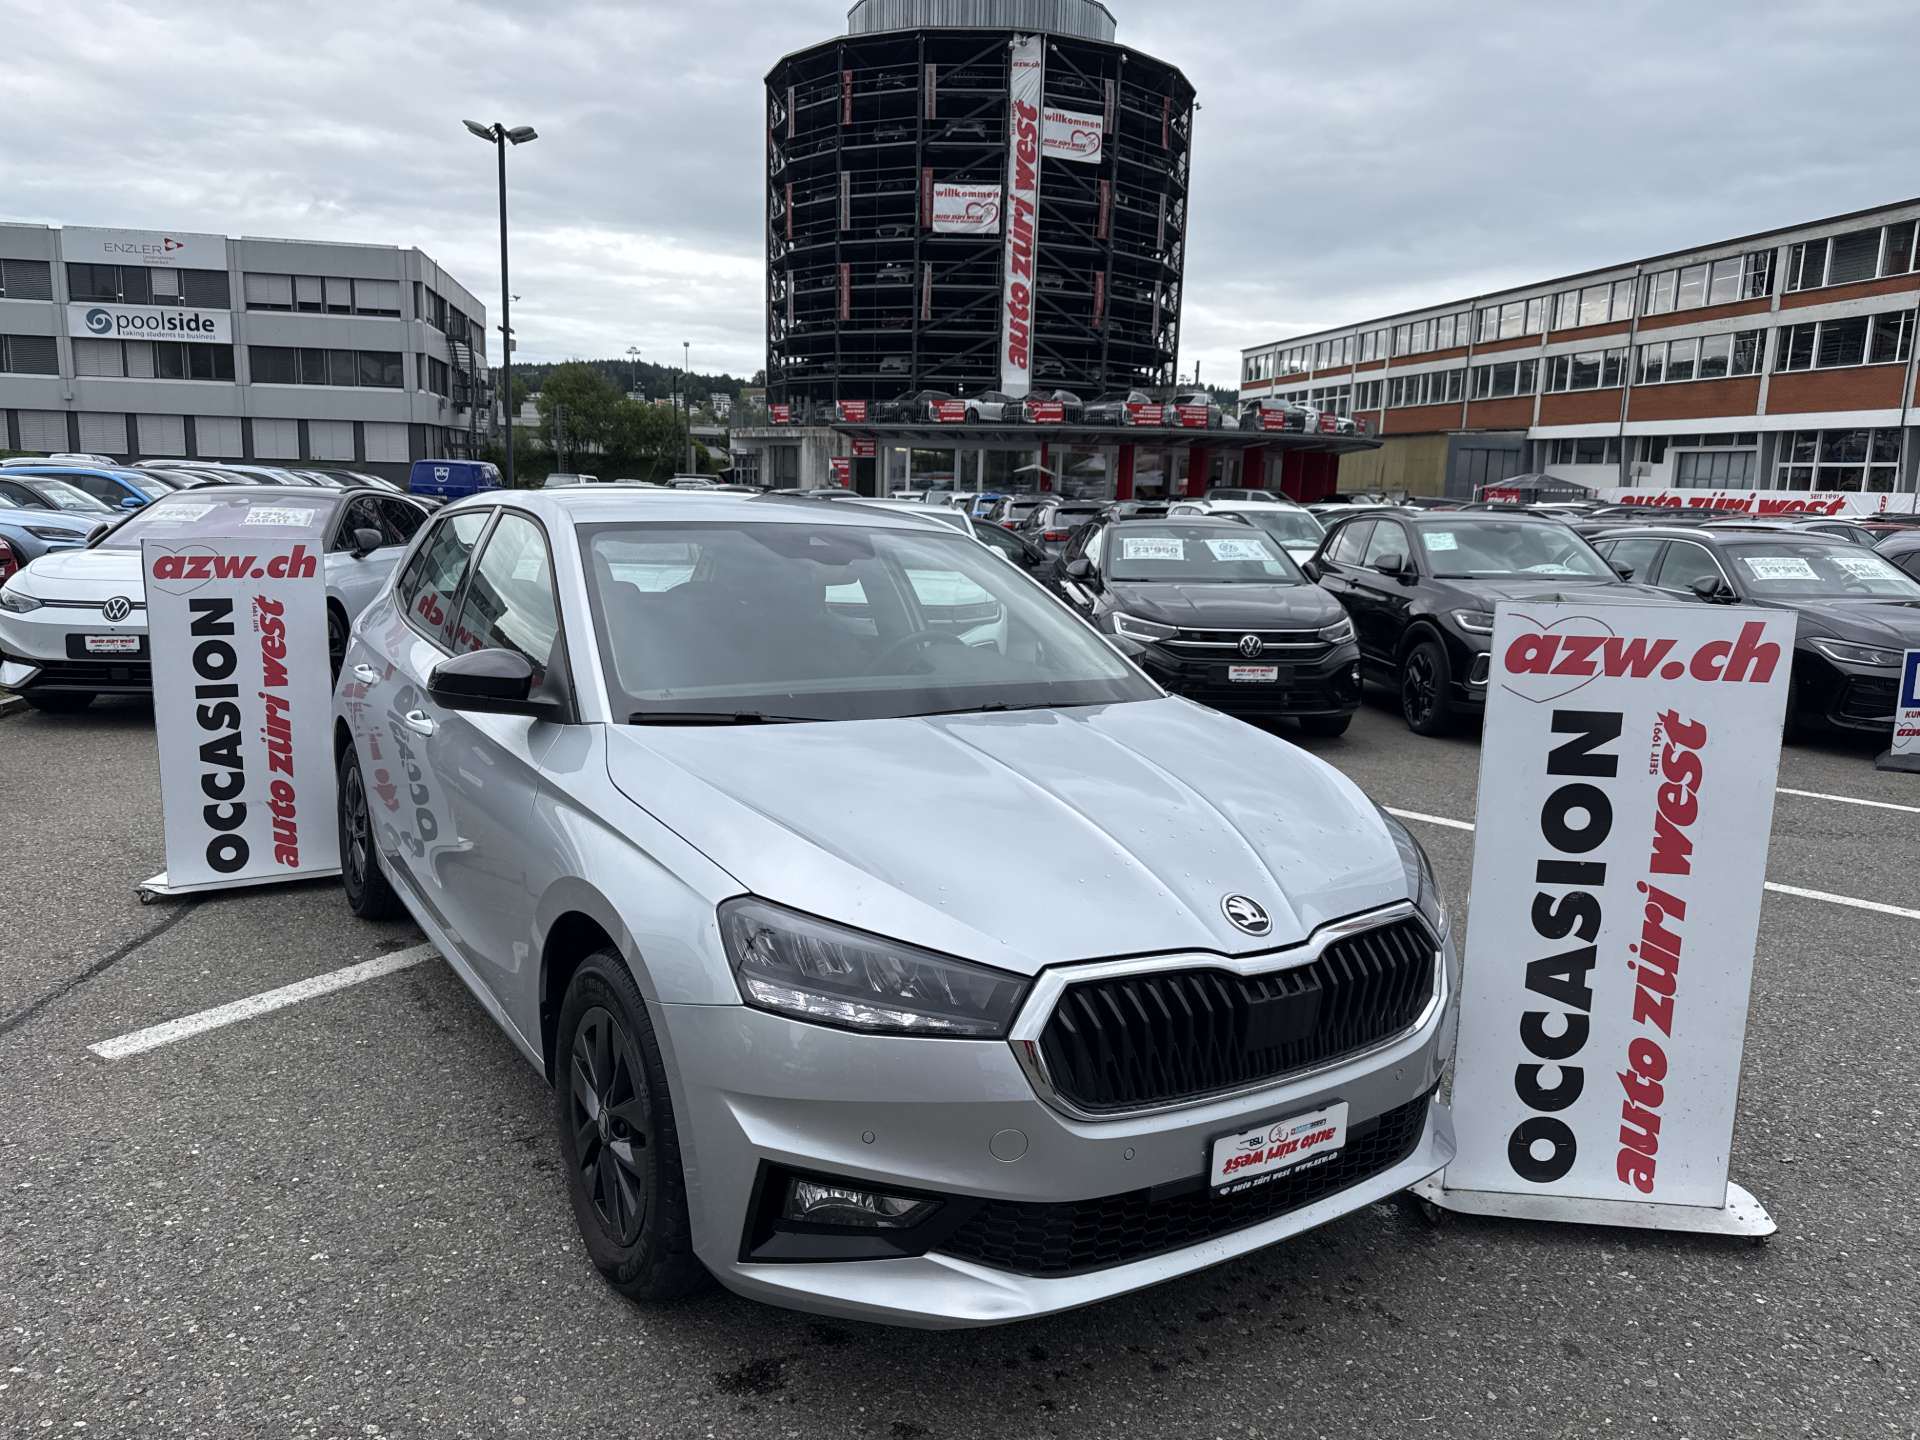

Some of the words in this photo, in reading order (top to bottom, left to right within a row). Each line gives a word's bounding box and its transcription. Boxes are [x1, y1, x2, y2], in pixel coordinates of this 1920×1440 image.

[1044, 112, 1102, 129] willkommen
[1014, 99, 1039, 190] west
[935, 188, 999, 198] willkommen
[104, 242, 163, 255] ENZLER
[1007, 194, 1035, 282] züri
[116, 311, 216, 335] poolside
[122, 330, 146, 338] taking
[146, 331, 177, 339] students
[186, 332, 216, 340] business
[1006, 282, 1030, 370] auto
[1620, 491, 1682, 508] auto
[153, 545, 317, 579] azw.ch
[252, 594, 288, 687] west
[1504, 621, 1781, 683] azw.ch
[189, 598, 250, 874] OCCASION
[258, 691, 294, 778] züri
[1652, 722, 1663, 751] 1991
[1649, 752, 1660, 776] SEIT
[1650, 708, 1707, 876] west
[266, 780, 300, 868] auto
[1507, 709, 1623, 1184] OCCASION
[1627, 880, 1687, 1039] züri
[1616, 1037, 1668, 1194] auto
[1265, 1138, 1301, 1164] züri
[1301, 1127, 1336, 1149] auto
[1222, 1150, 1263, 1175] west
[1231, 1181, 1251, 1192] auto
[1252, 1174, 1272, 1186] züri
[1272, 1168, 1291, 1180] west
